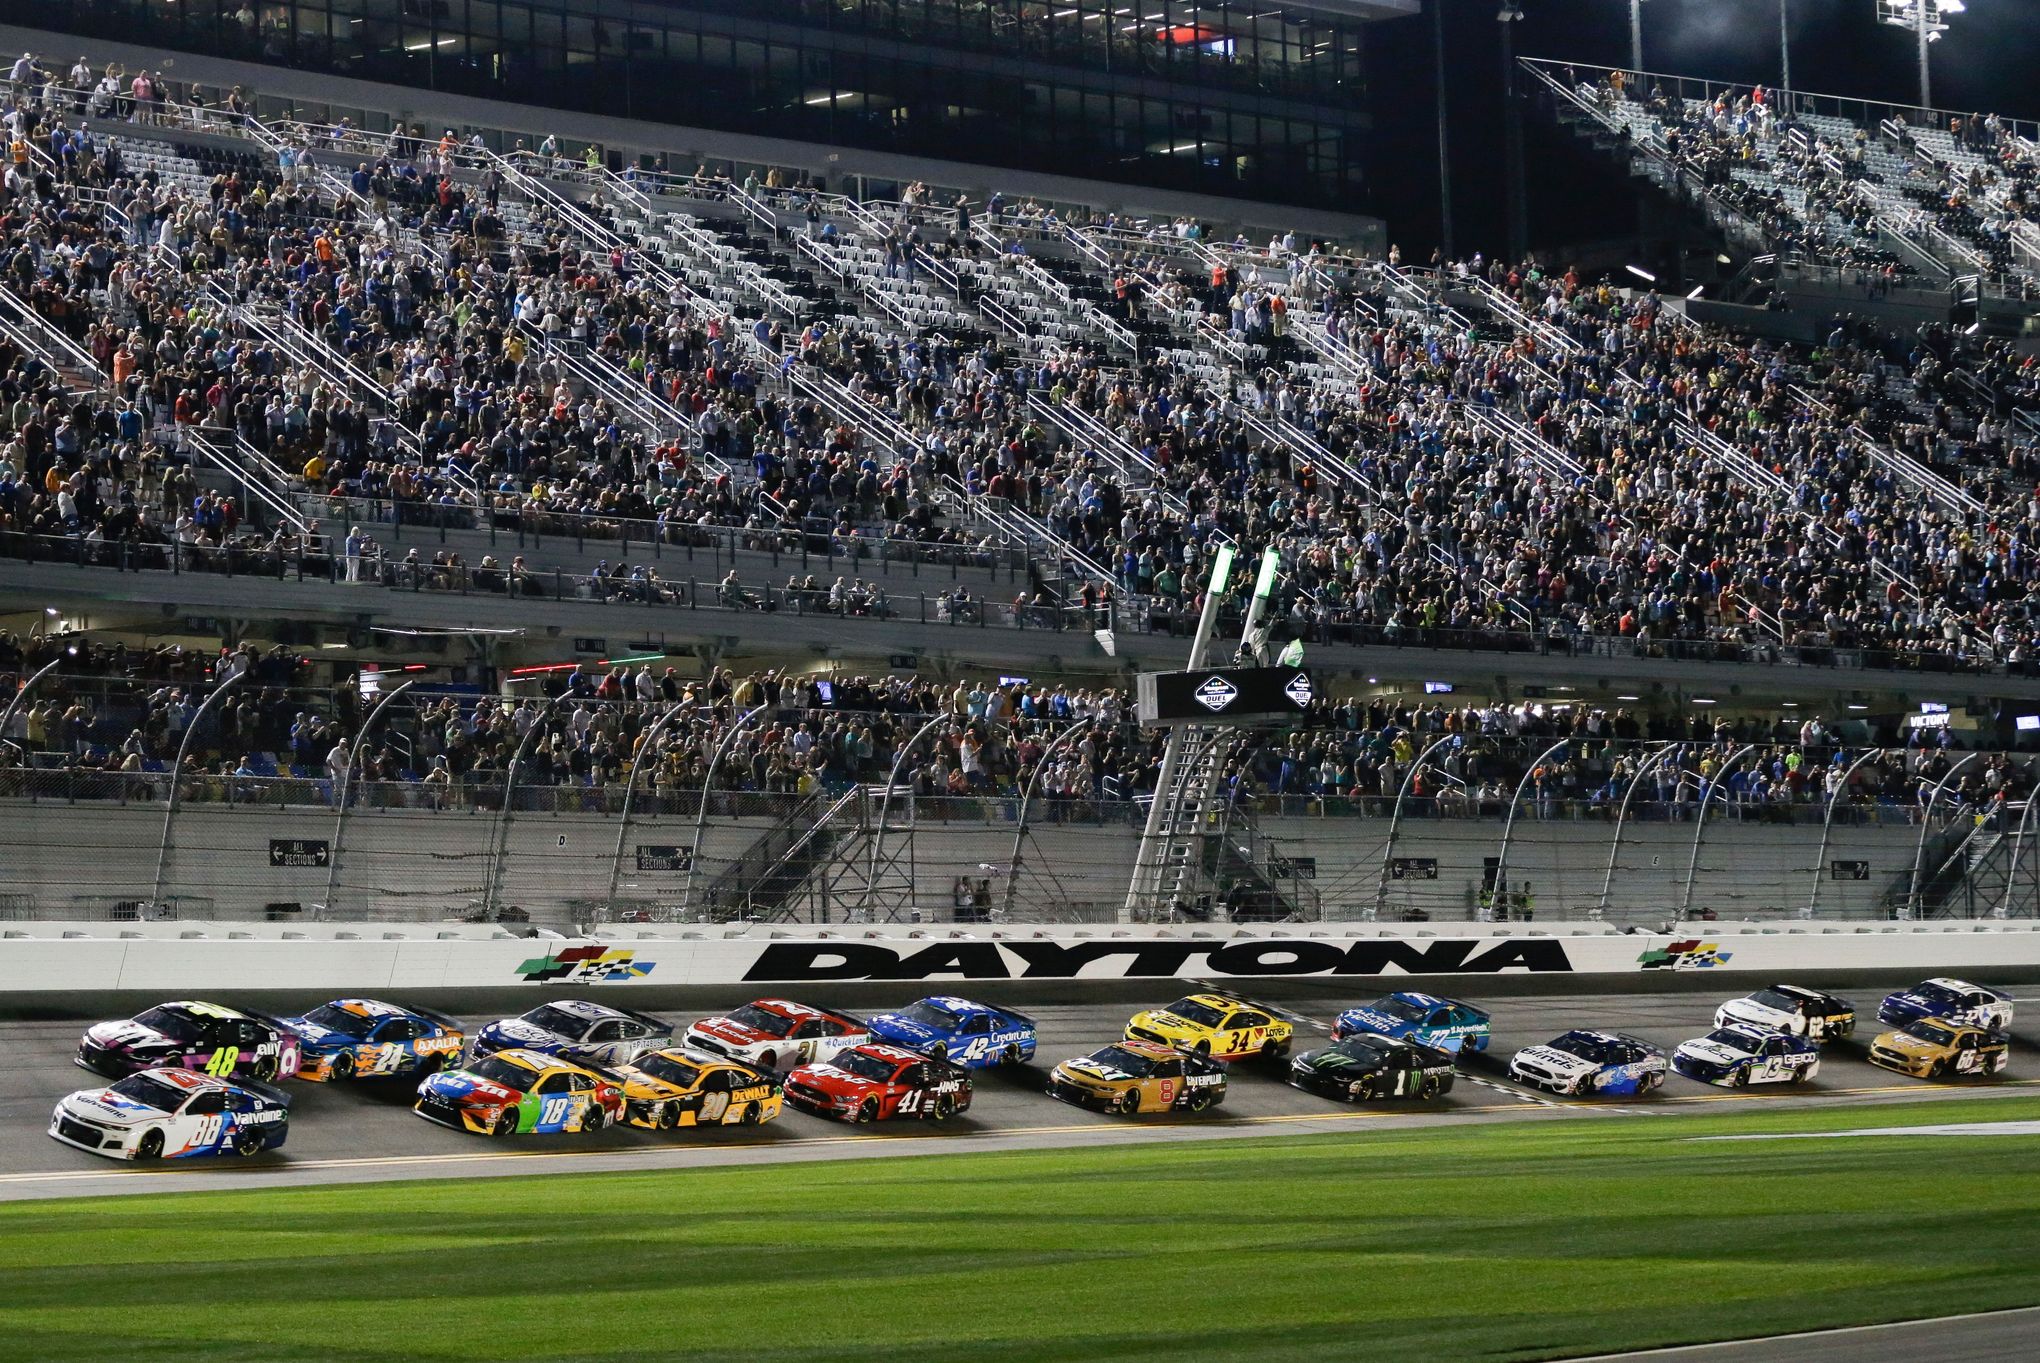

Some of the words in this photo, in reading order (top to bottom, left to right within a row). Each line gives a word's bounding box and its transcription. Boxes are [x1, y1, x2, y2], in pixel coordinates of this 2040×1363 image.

[116, 99, 128, 117] L2
[1910, 713, 1950, 727] VICTORY
[558, 835, 566, 846] D
[284, 854, 316, 865] SECTIONS
[741, 939, 1573, 981] DAYTONA
[1808, 1016, 1824, 1037] 62
[257, 1041, 283, 1057] ally
[417, 1037, 460, 1051] AXALTA
[833, 1039, 851, 1047] Quick
[963, 1038, 988, 1060] 42
[1226, 1031, 1250, 1053] 34
[1427, 1030, 1450, 1050] 77
[205, 1046, 239, 1078] 48
[374, 1044, 405, 1072] 24
[1520, 1048, 1575, 1070] Blinds
[1761, 1055, 1783, 1079] 13
[1784, 1053, 1816, 1067] GEICO
[1956, 1050, 1977, 1070] 66
[938, 1080, 961, 1093] HAAS
[1186, 1074, 1222, 1086] CATERPILLAR
[1394, 1070, 1406, 1096] 1
[732, 1086, 770, 1102] DEWALT
[898, 1089, 922, 1113] 41
[1160, 1079, 1175, 1103] 8
[77, 1095, 127, 1119] Valvoline
[540, 1098, 569, 1125] 18
[697, 1092, 729, 1120] 20
[231, 1110, 282, 1125] Valvoline
[188, 1115, 223, 1146] 88
